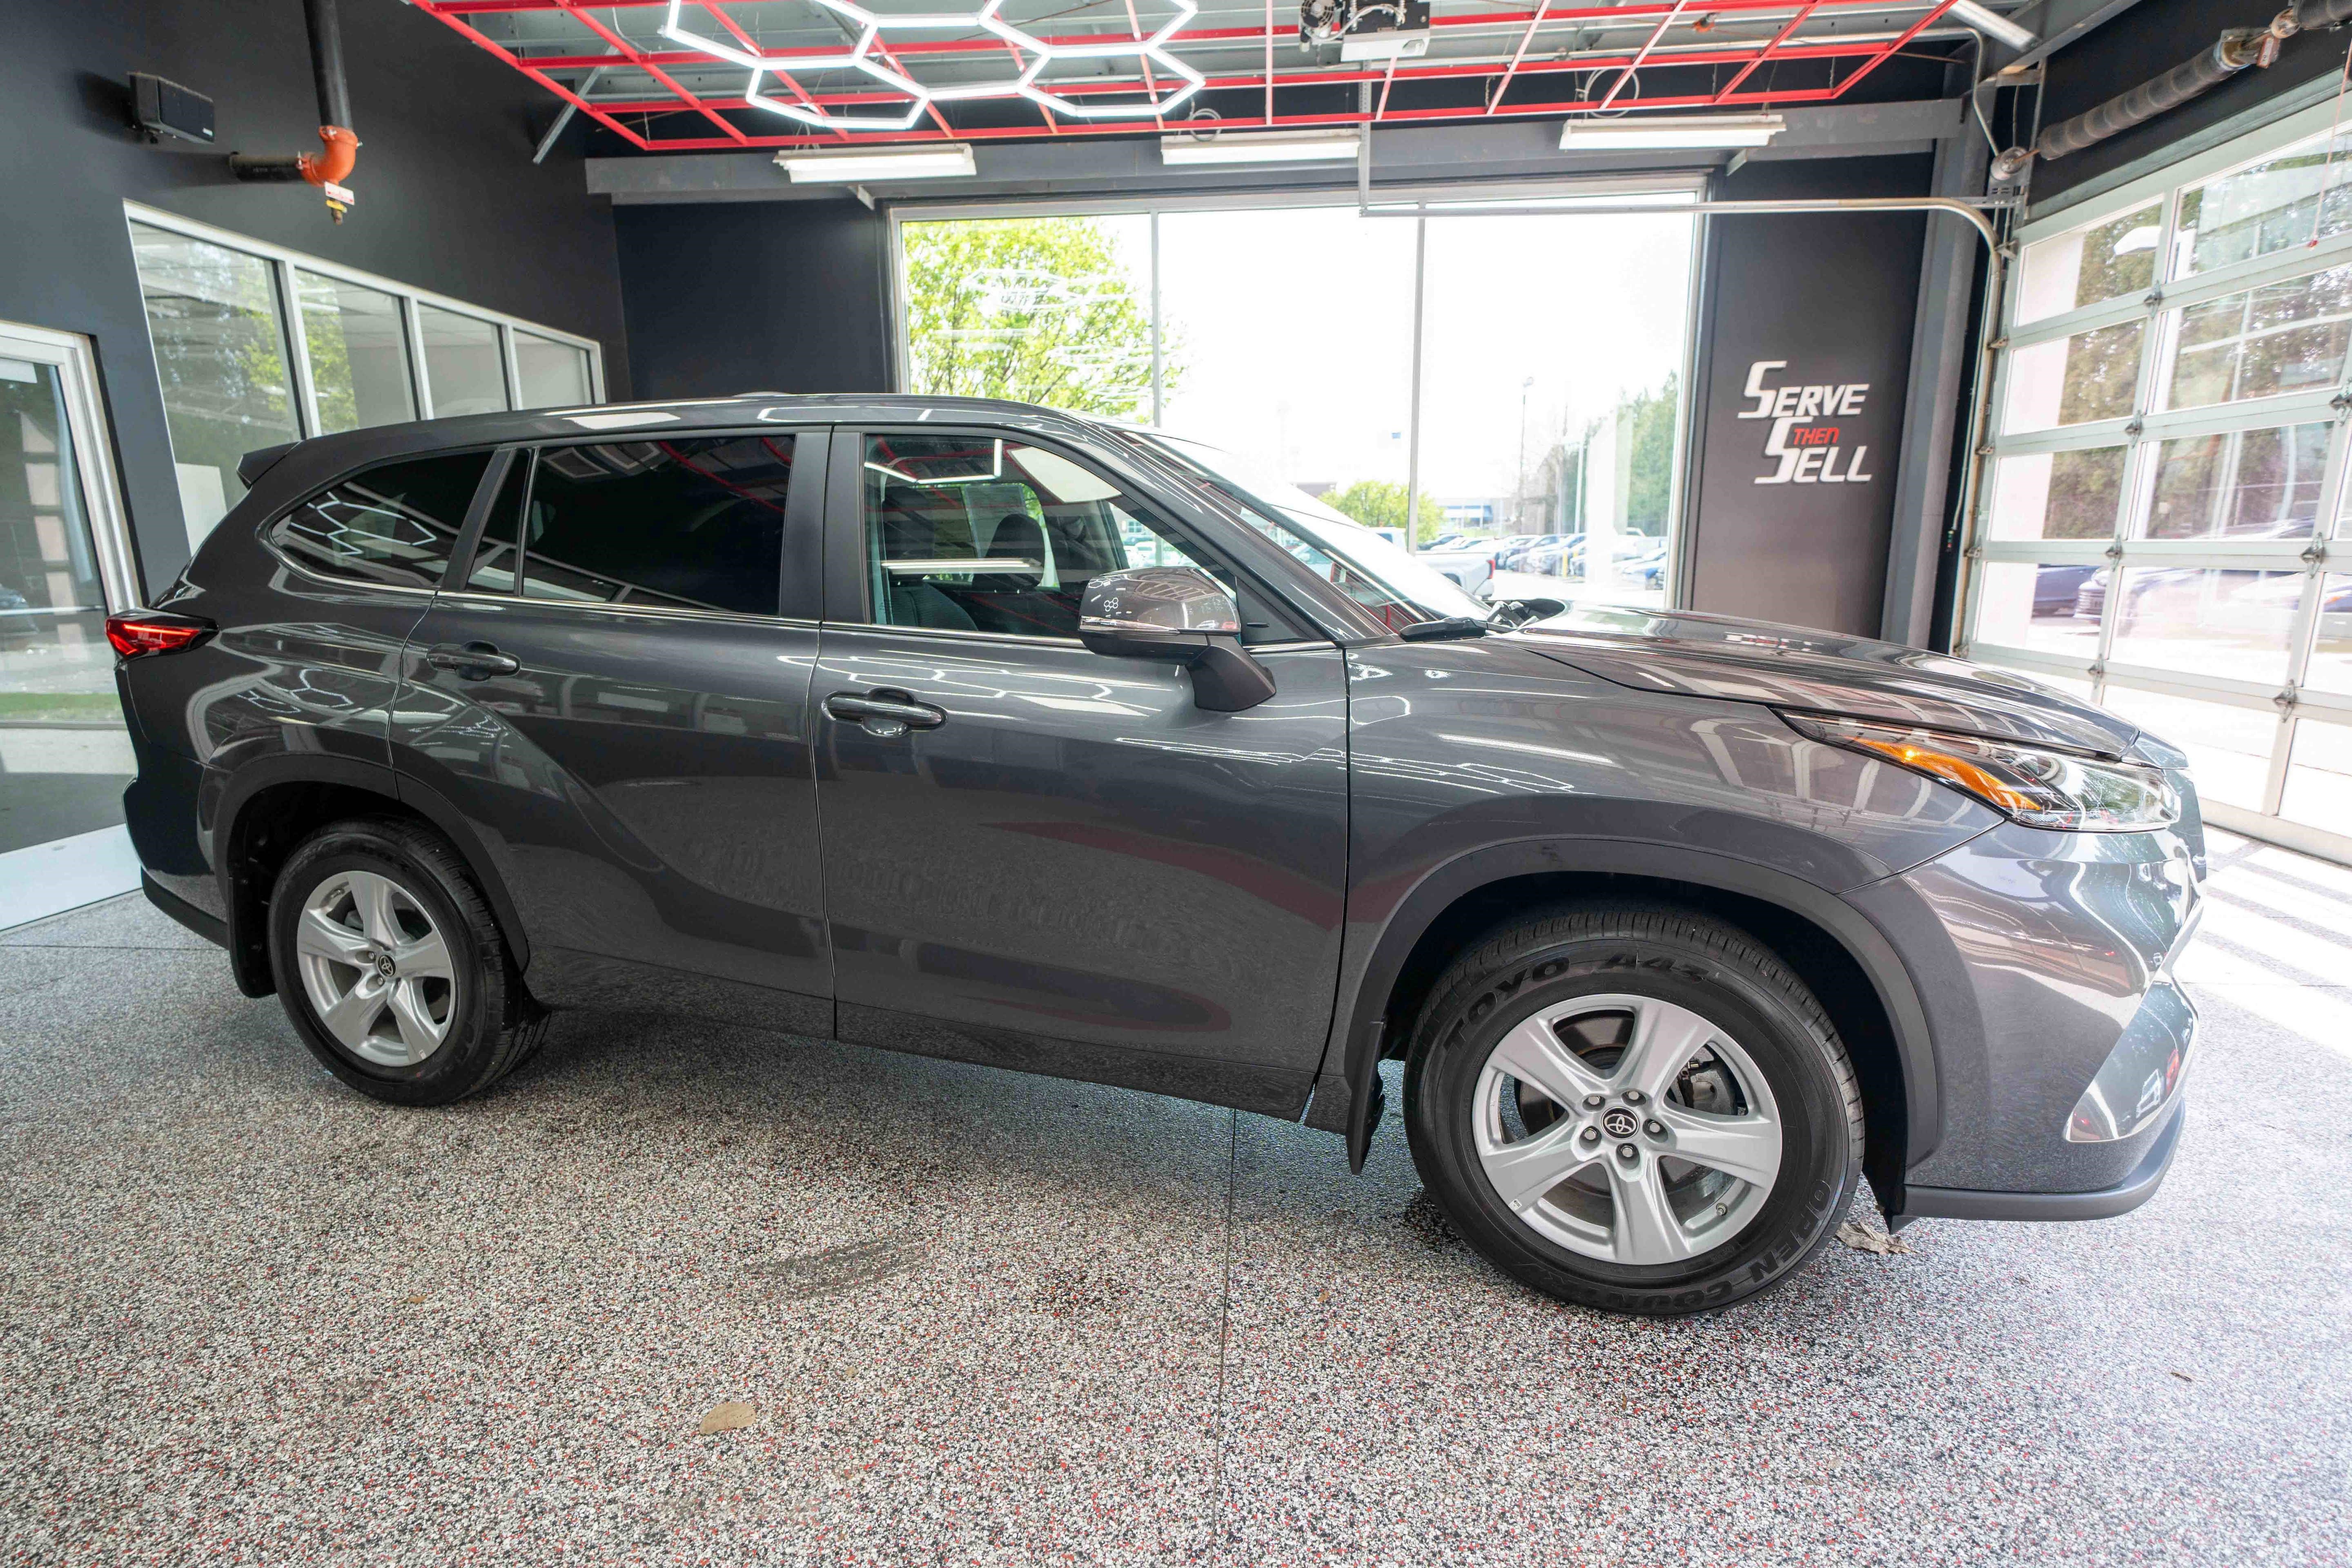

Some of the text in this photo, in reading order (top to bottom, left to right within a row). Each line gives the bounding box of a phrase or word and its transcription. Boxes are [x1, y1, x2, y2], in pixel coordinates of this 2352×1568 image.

[1737, 360, 1870, 419] SERVE
[1754, 416, 1872, 484] SELL
[1793, 427, 1840, 445] THEN
[1443, 956, 1571, 1052] TOYO
[1748, 1179, 1831, 1283] OPEN
